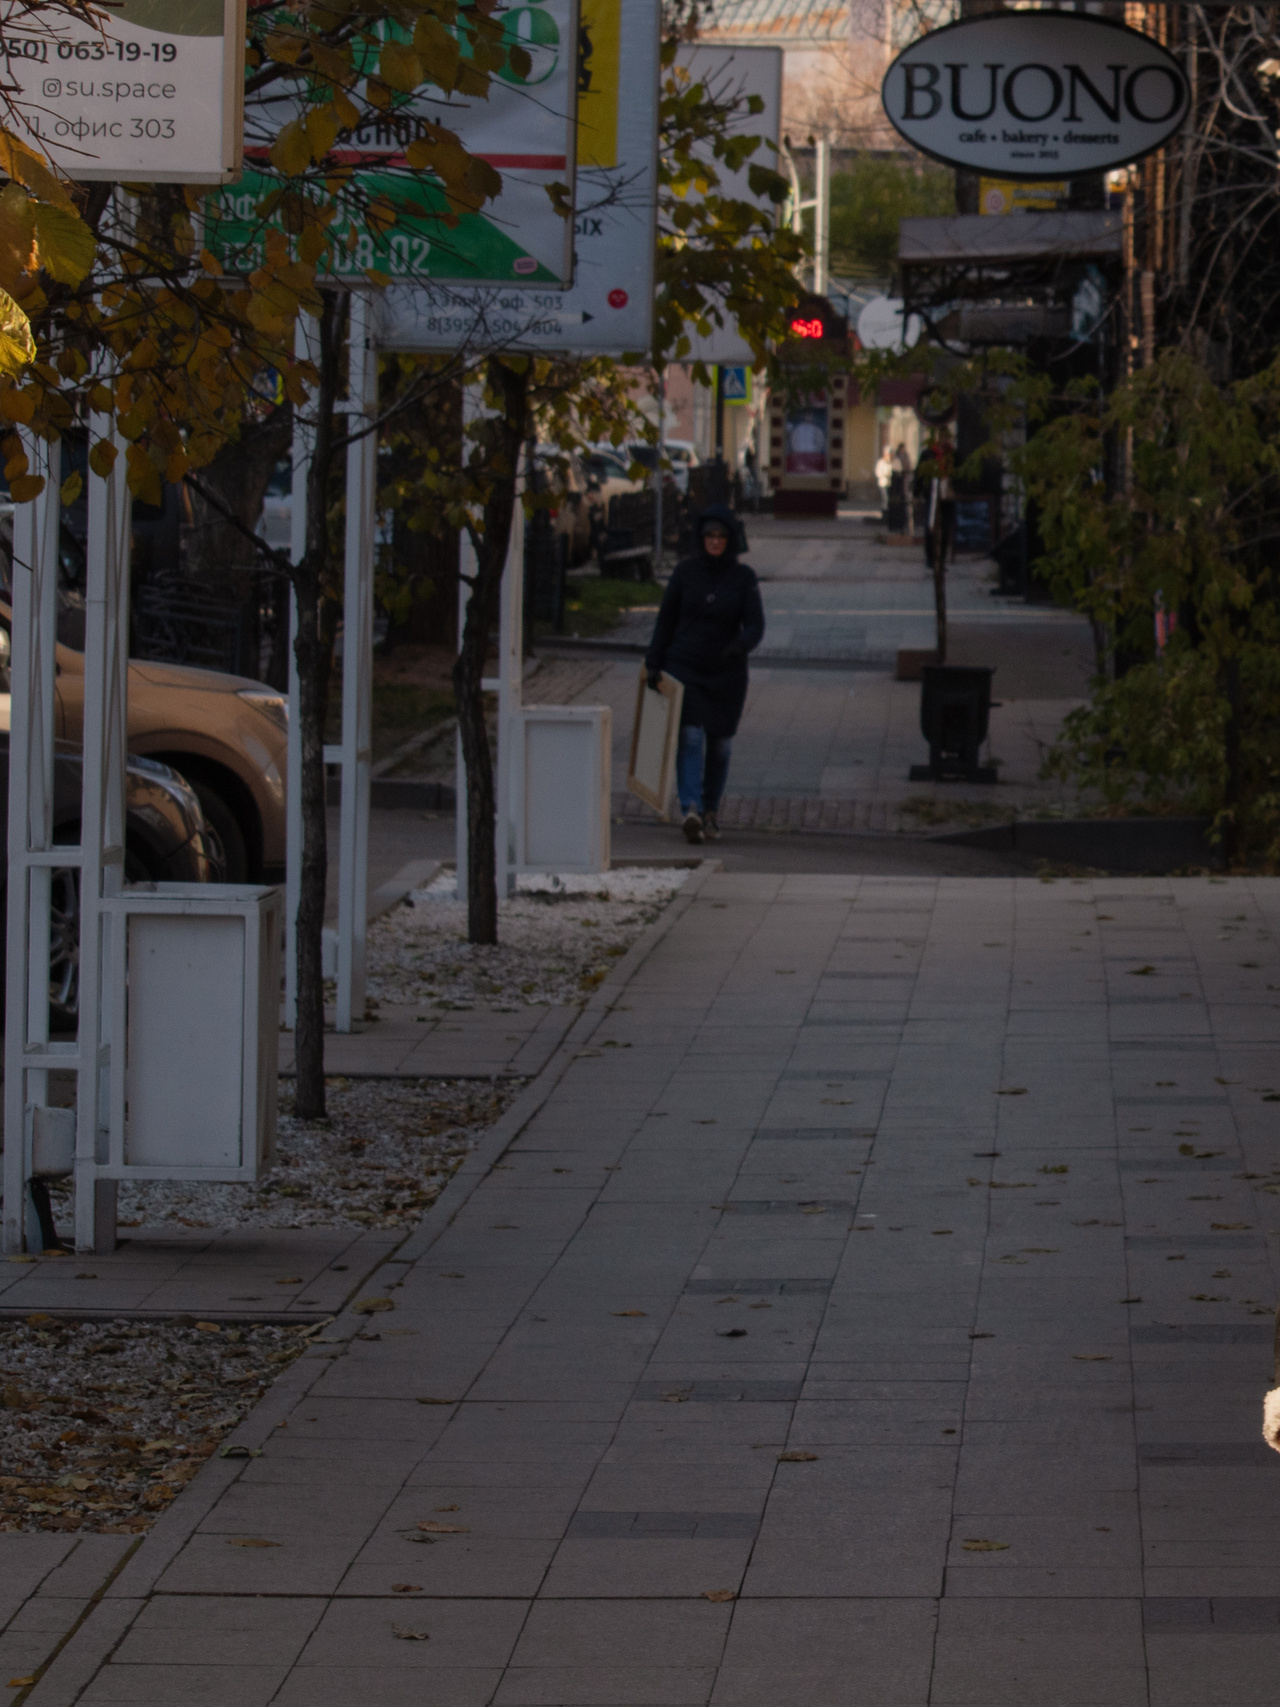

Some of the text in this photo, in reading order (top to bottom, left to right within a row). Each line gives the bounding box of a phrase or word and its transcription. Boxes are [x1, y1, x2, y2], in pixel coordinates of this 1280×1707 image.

[57, 41, 178, 63] 063-19-19
[901, 62, 1185, 123] BUONO
[55, 116, 123, 141] офис
[130, 118, 176, 139] 303
[959, 129, 1119, 147] cafe bakery desserts
[534, 295, 564, 310] 503
